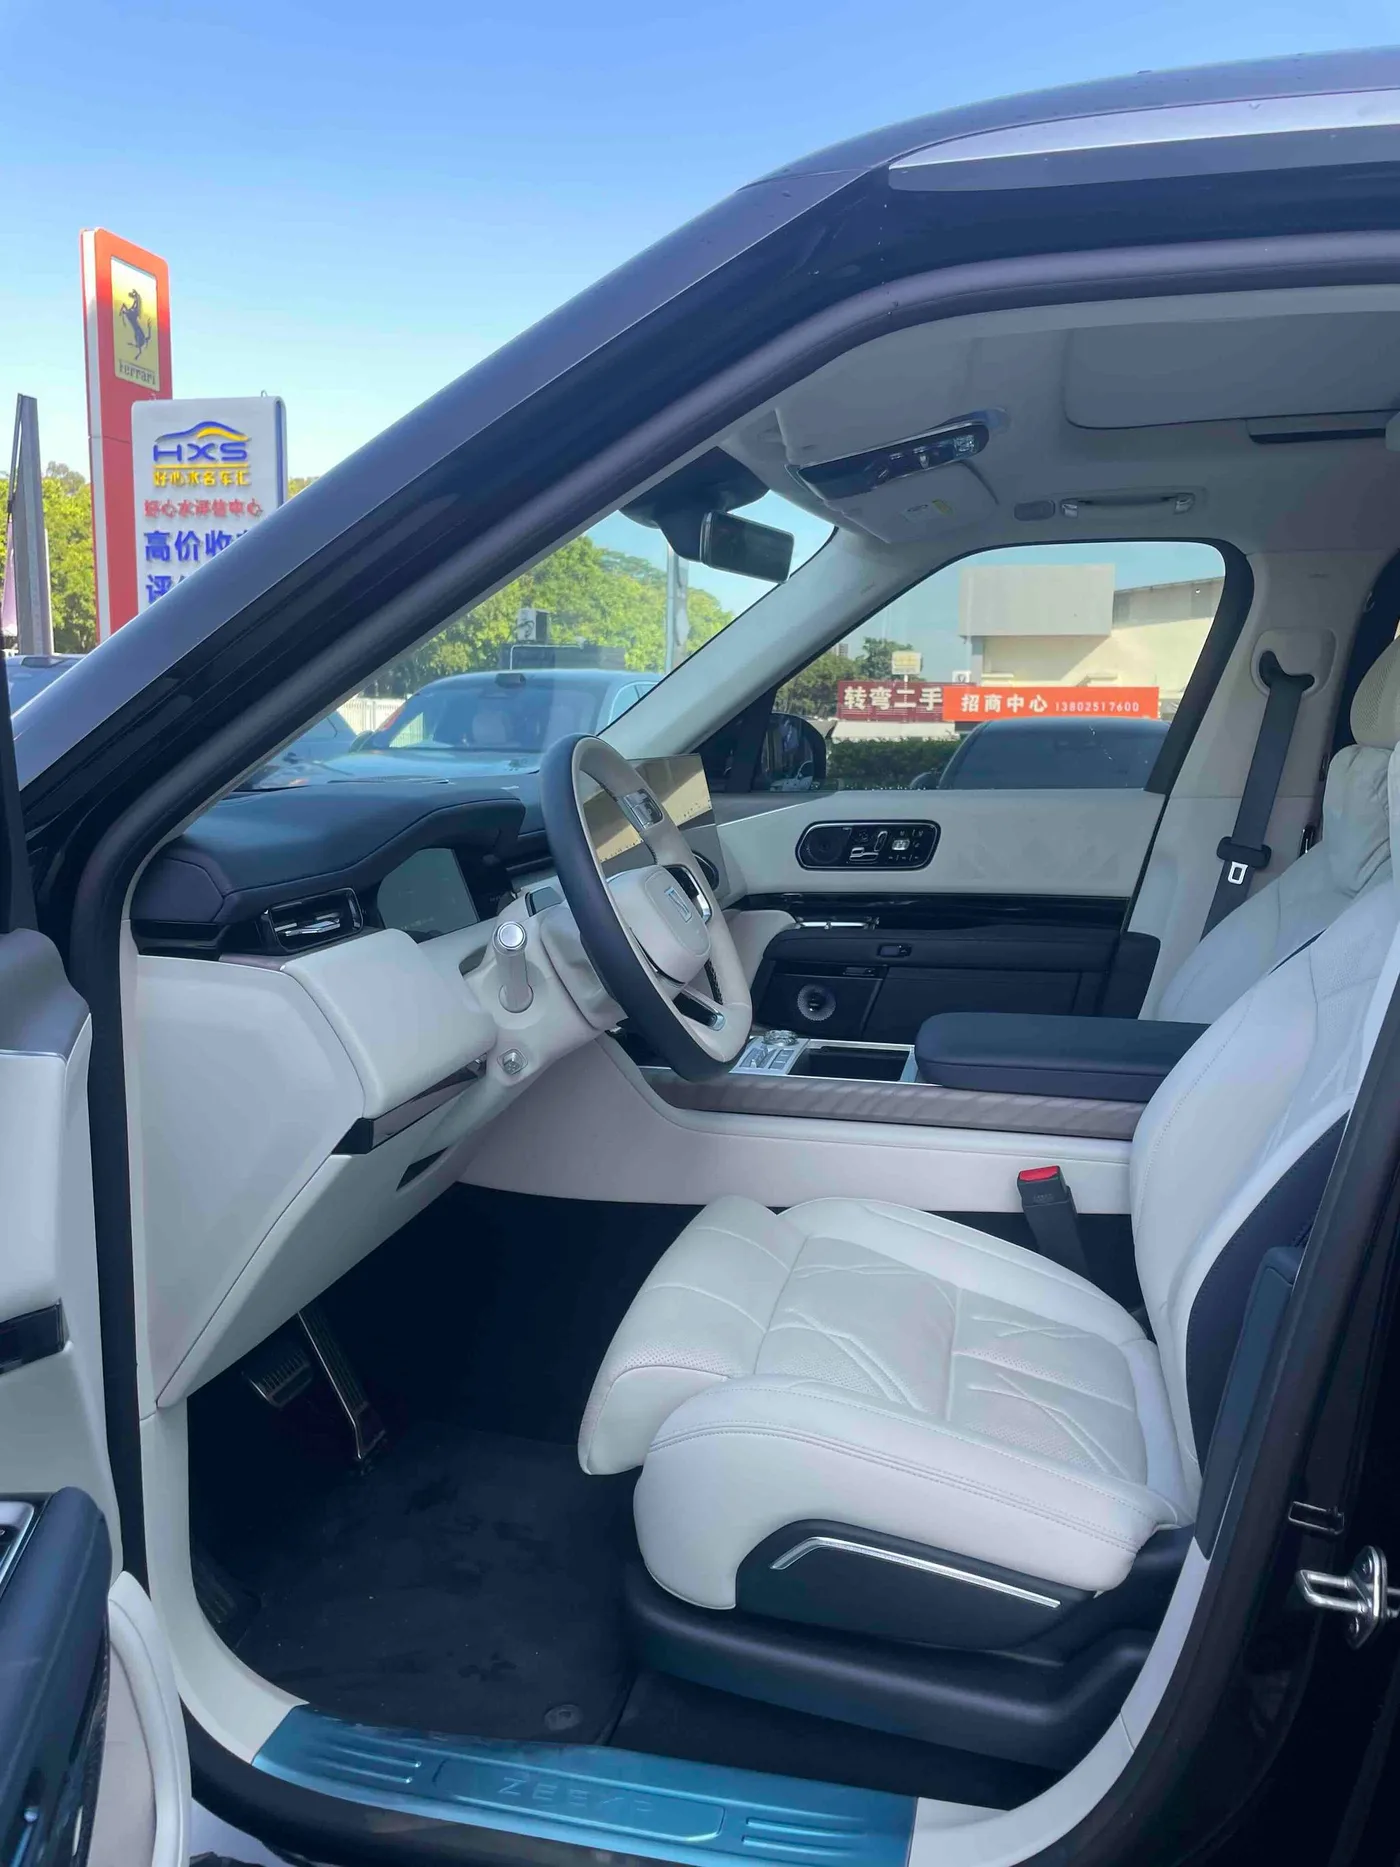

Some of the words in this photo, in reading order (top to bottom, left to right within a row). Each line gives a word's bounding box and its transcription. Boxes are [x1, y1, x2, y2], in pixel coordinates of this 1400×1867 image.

[118, 359, 156, 385] Ferrari
[153, 442, 248, 462] HXS
[153, 470, 250, 488] 好心水名车汇
[844, 686, 943, 711] 转弯二手
[961, 693, 1048, 713] 招商中心
[1055, 701, 1140, 712] 13802517600
